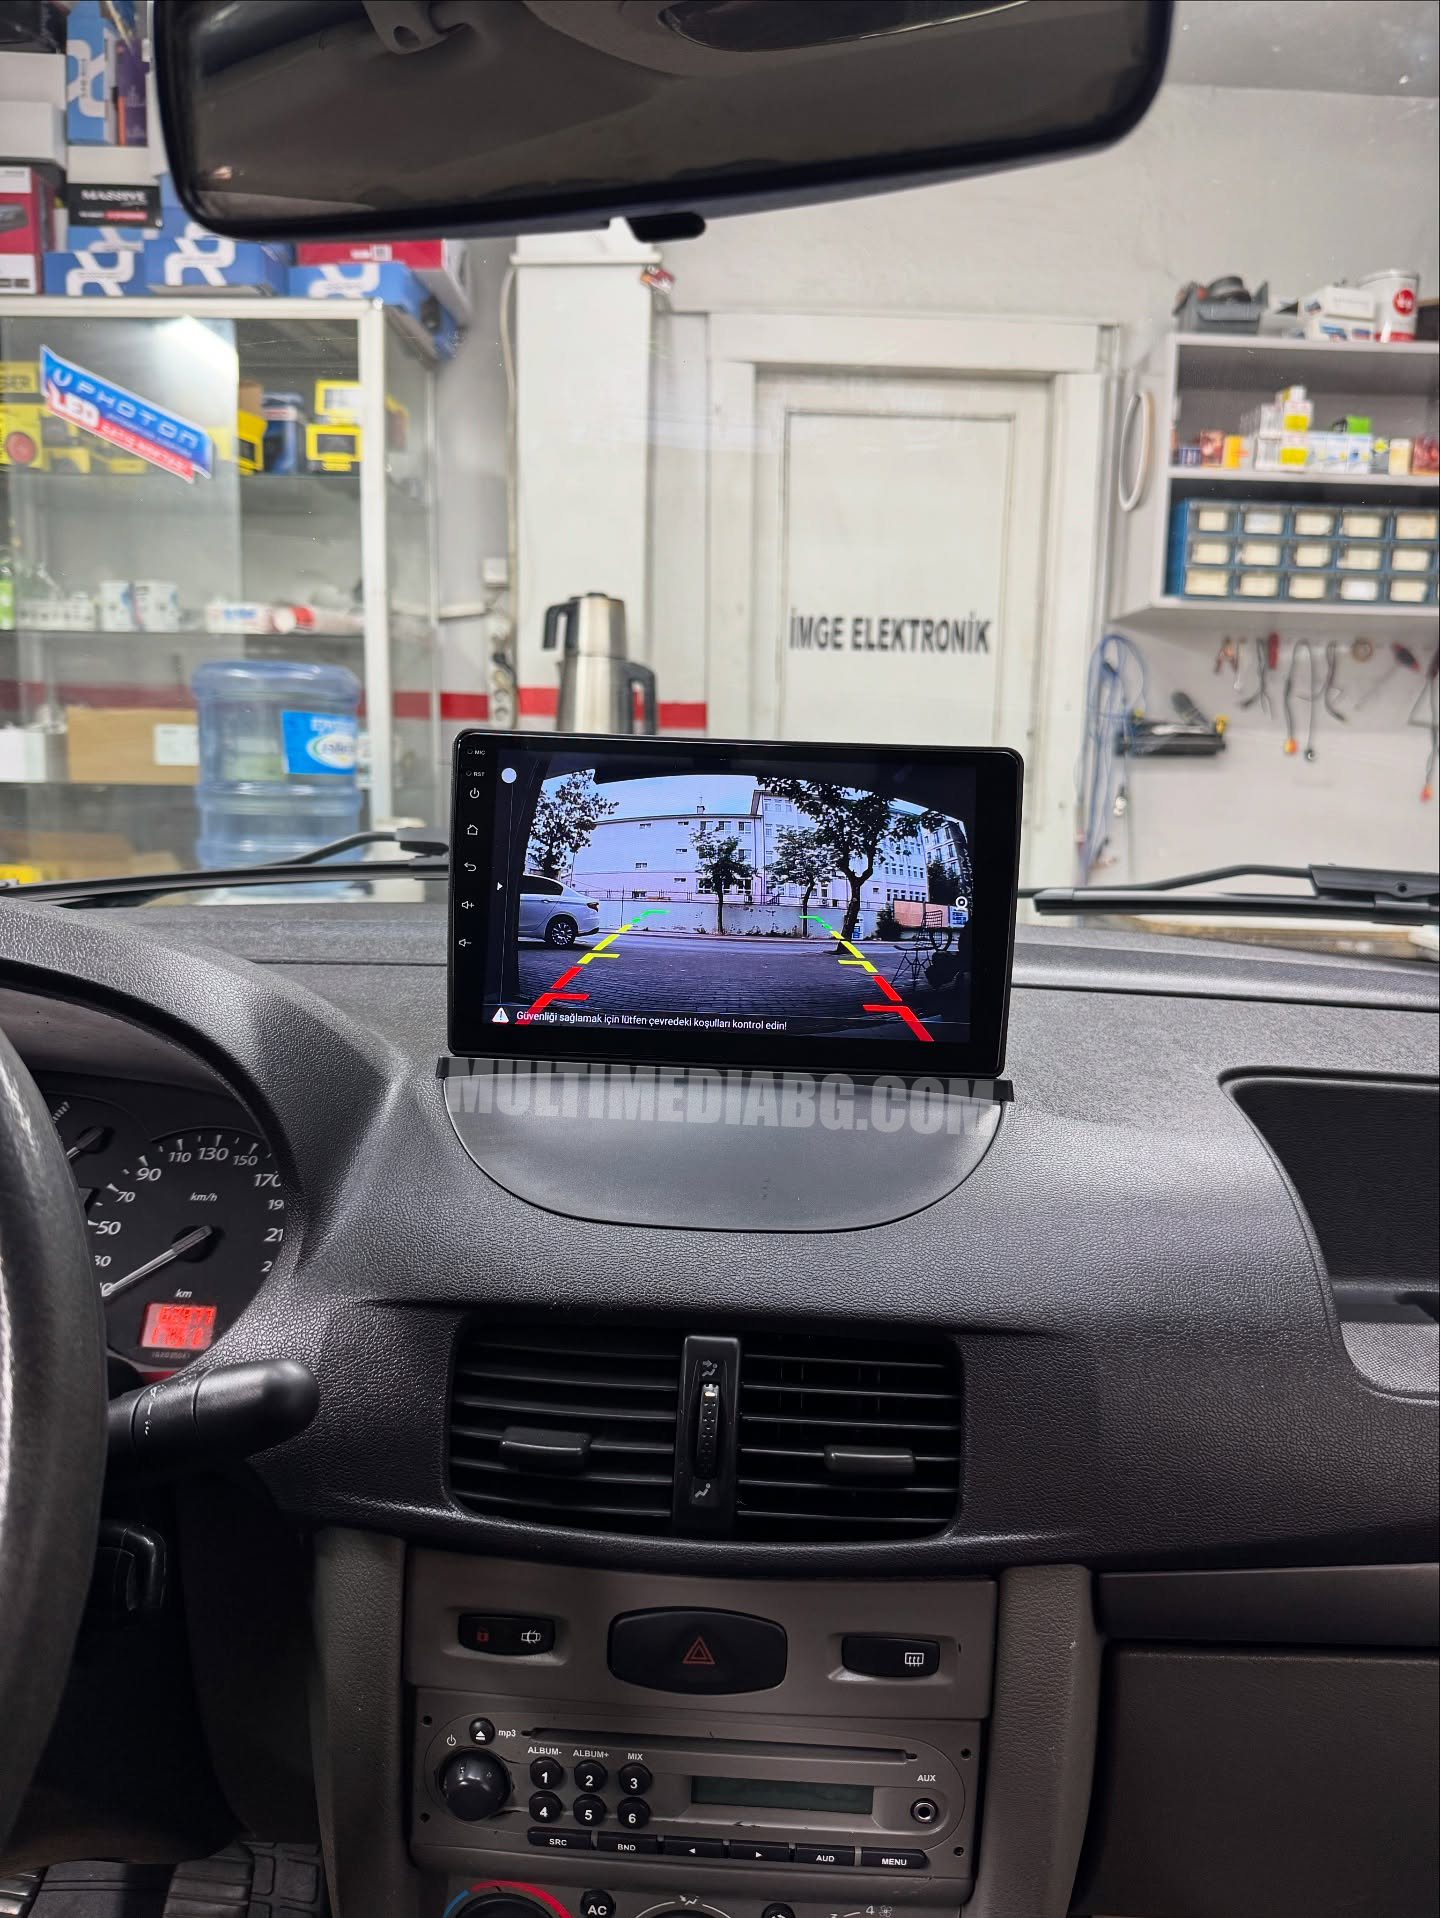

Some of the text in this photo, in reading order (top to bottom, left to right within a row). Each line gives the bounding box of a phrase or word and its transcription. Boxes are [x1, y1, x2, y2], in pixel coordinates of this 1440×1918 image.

[851, 608, 992, 654] ELEKTRONİK
[516, 1011, 788, 1031] Güvenliği sağlamak için lütfen çevredeki koşulları kontrol edin!
[168, 1151, 192, 1163] 110
[199, 1147, 229, 1161] 130
[232, 1155, 259, 1166] 150
[136, 1167, 162, 1182] 90
[116, 1191, 136, 1203] 70
[190, 1192, 218, 1203] km/h
[268, 1200, 285, 1211] 19
[95, 1221, 122, 1235] 50
[263, 1229, 284, 1242] 21
[175, 1288, 193, 1298] km
[498, 1728, 517, 1739] mp3
[527, 1746, 562, 1756] ALBUM-
[572, 1749, 609, 1759] ALBUM+
[627, 1752, 643, 1761] MIX
[541, 1771, 549, 1784] 1
[585, 1775, 594, 1787] 2
[917, 1774, 936, 1782] AUX
[630, 1777, 638, 1790] 3
[539, 1806, 549, 1818] 4
[584, 1809, 593, 1821] 5
[628, 1813, 637, 1824] 6
[549, 1838, 568, 1847] SRC
[617, 1843, 636, 1852] BND
[815, 1854, 835, 1863] AUD
[881, 1857, 907, 1867] MENU
[587, 1904, 607, 1917] AC
[865, 1905, 875, 1915] 4
